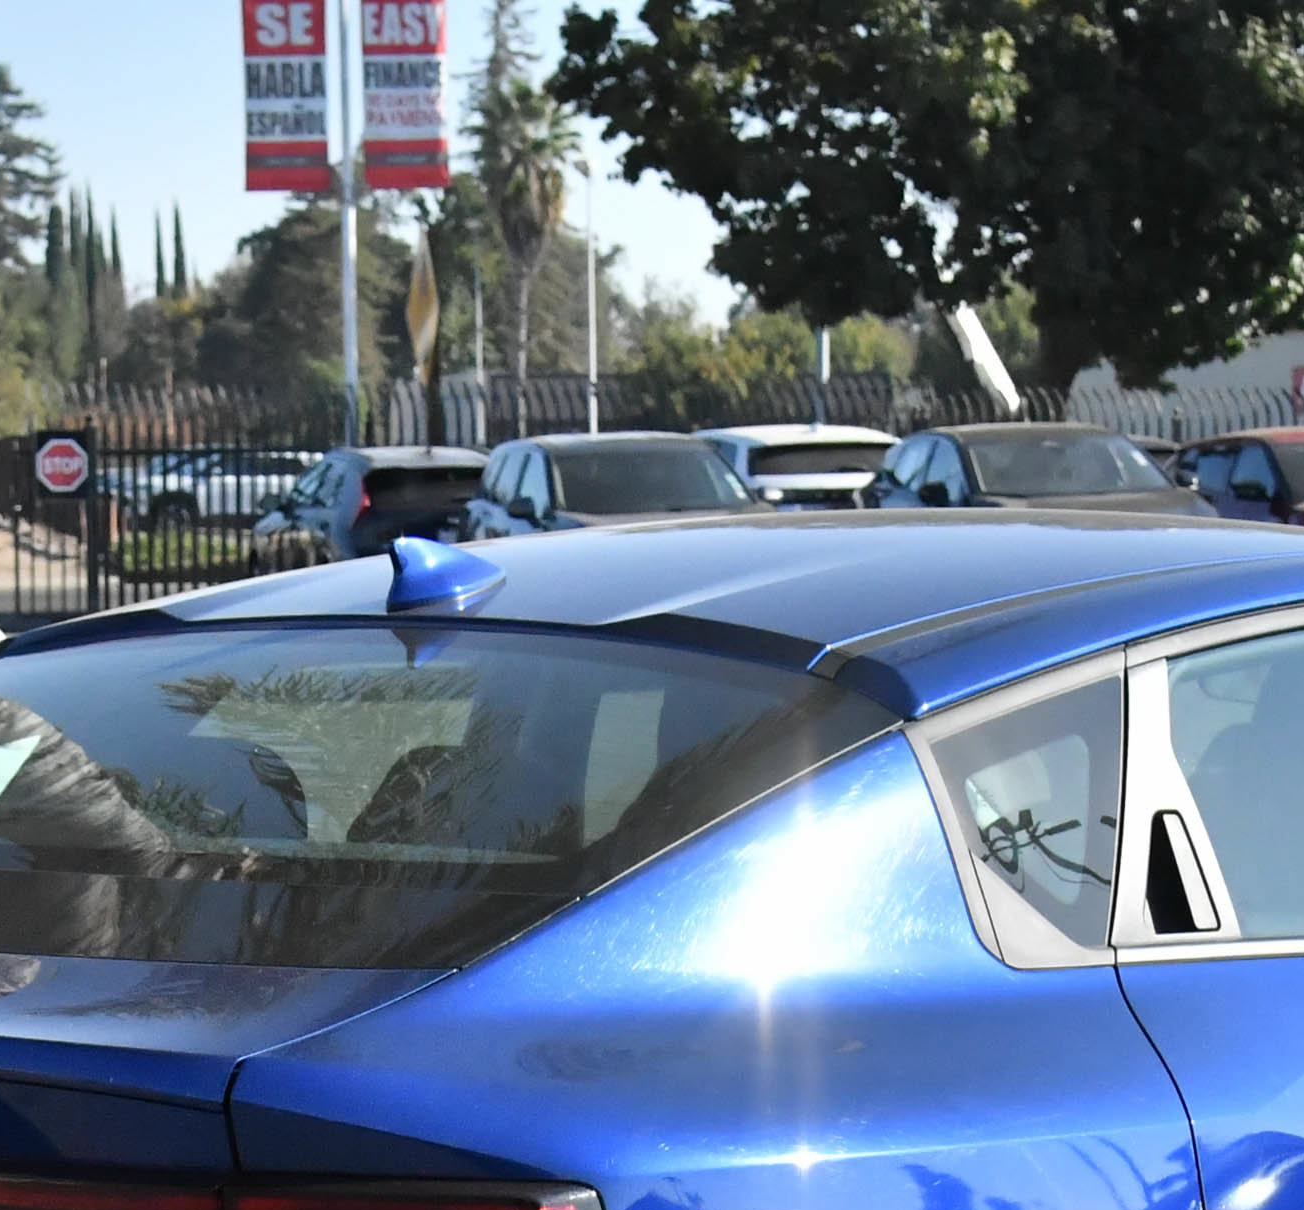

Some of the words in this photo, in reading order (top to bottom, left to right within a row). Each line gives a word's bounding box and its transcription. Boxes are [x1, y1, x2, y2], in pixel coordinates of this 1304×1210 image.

[255, 3, 314, 47] SE
[364, 3, 443, 46] EASY
[247, 61, 326, 98] HABLA
[247, 104, 326, 135] ESPAÑOL
[42, 455, 83, 475] STOP
